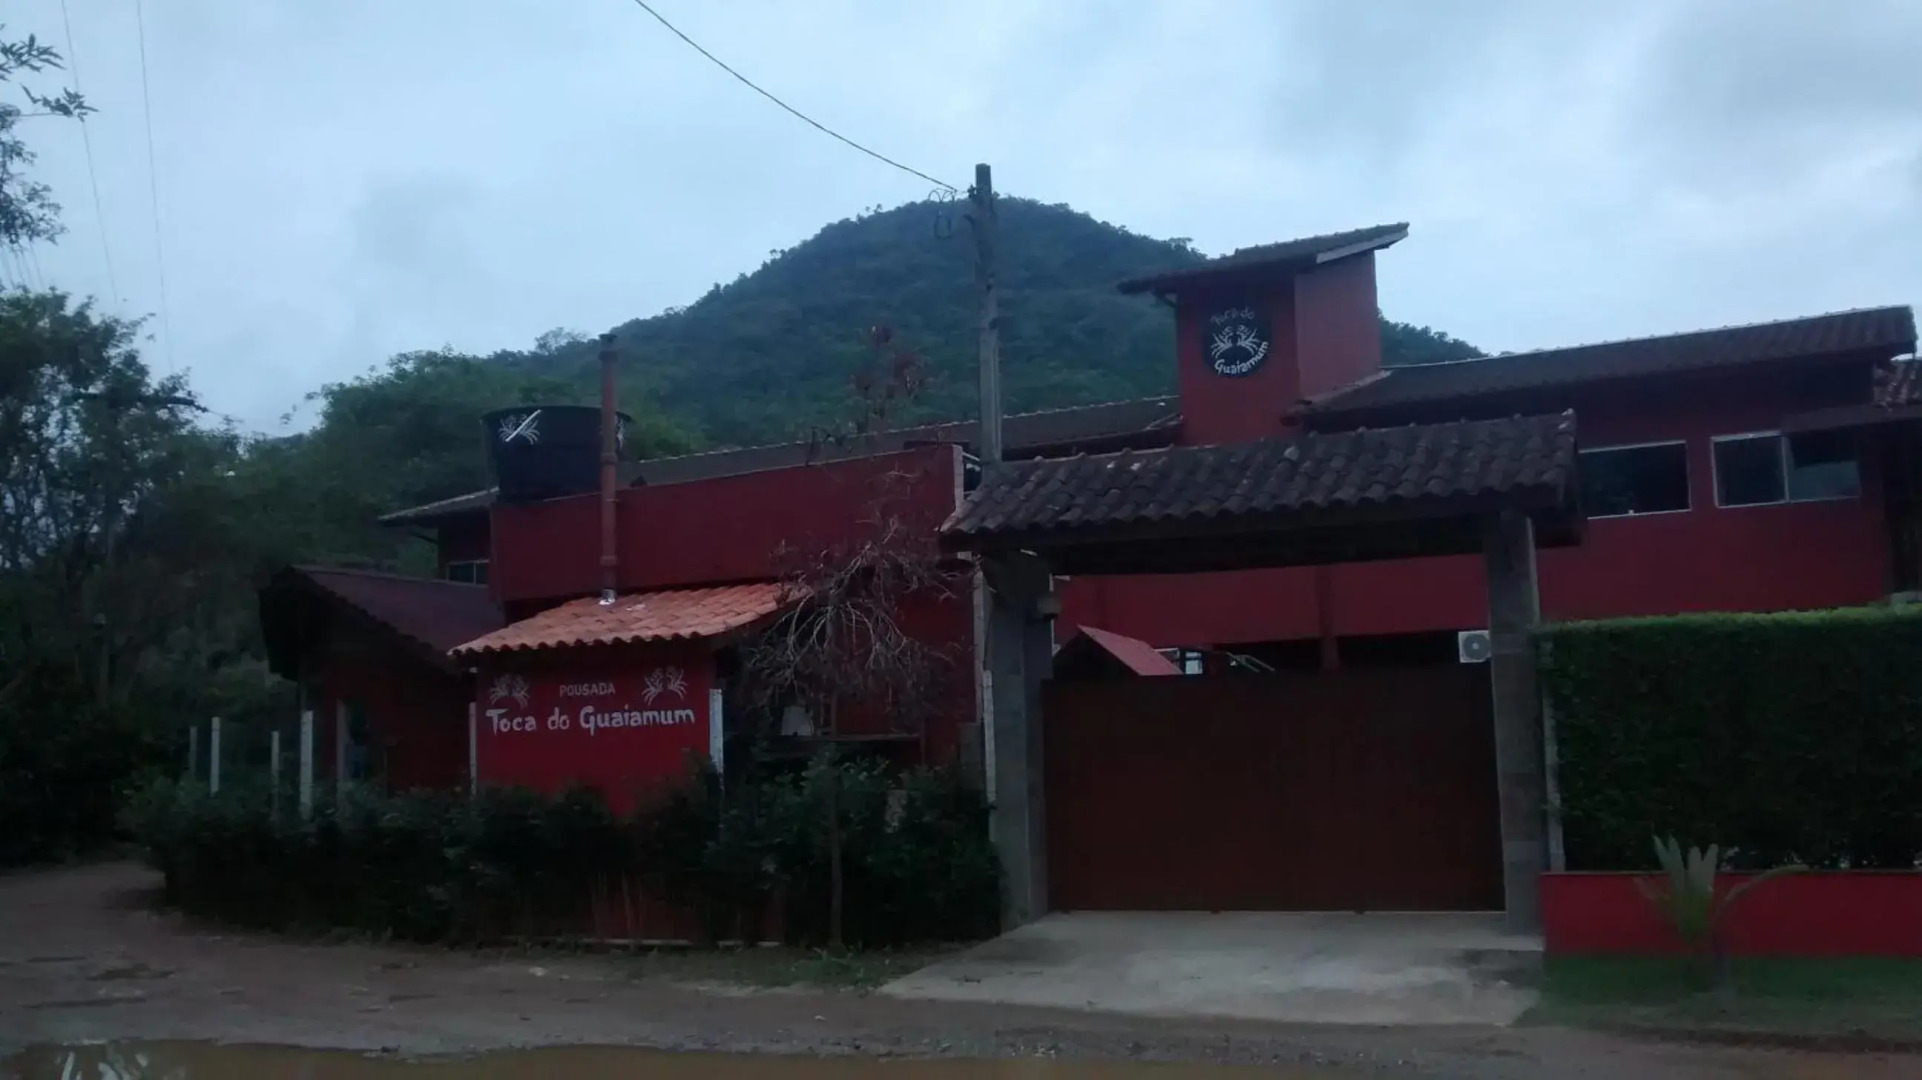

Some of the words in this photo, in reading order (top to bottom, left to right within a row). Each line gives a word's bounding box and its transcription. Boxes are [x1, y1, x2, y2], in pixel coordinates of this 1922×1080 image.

[1214, 341, 1269, 375] Guaiamum
[559, 682, 616, 698] POUSADA
[486, 708, 538, 735] Toca
[547, 706, 571, 731] do
[579, 704, 696, 736] Guaiamum
